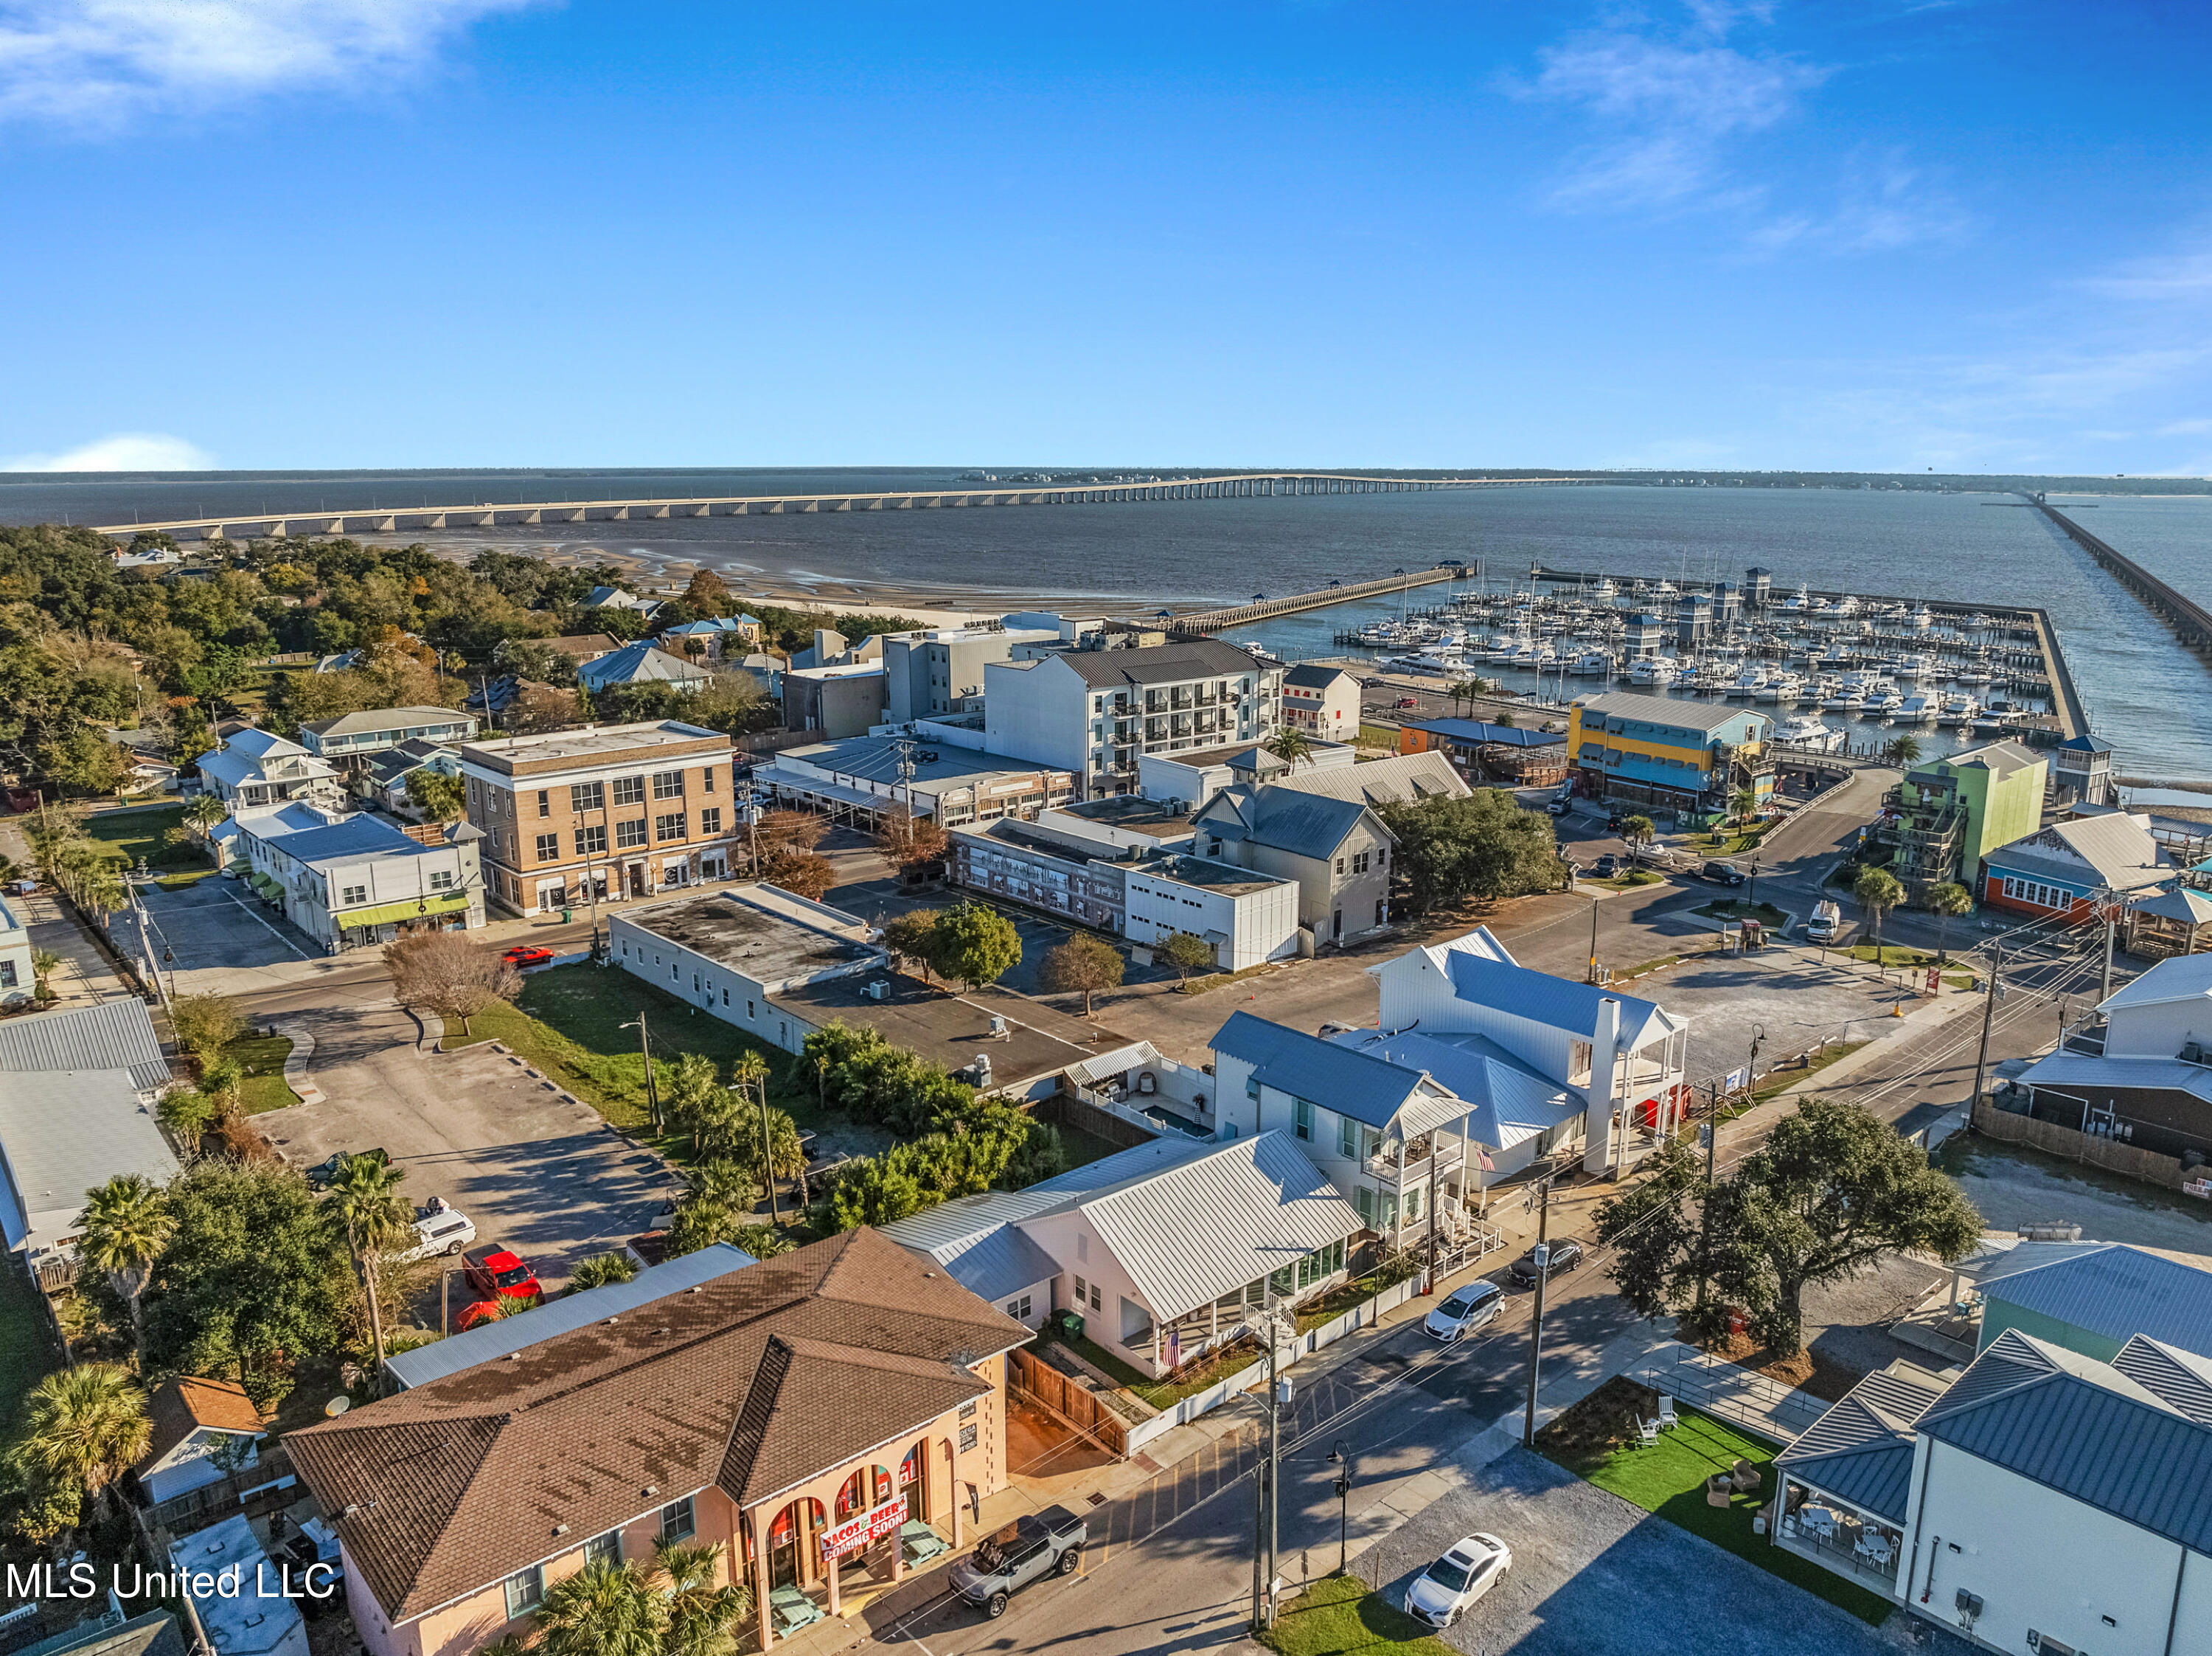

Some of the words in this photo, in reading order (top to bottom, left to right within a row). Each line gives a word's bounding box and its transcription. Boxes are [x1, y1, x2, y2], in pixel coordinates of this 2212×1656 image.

[2185, 1183, 2203, 1193] FREE
[823, 1521, 860, 1548] TACOS
[870, 1502, 899, 1525] BEER
[824, 1530, 870, 1562] COMING
[872, 1510, 908, 1537] SOON!
